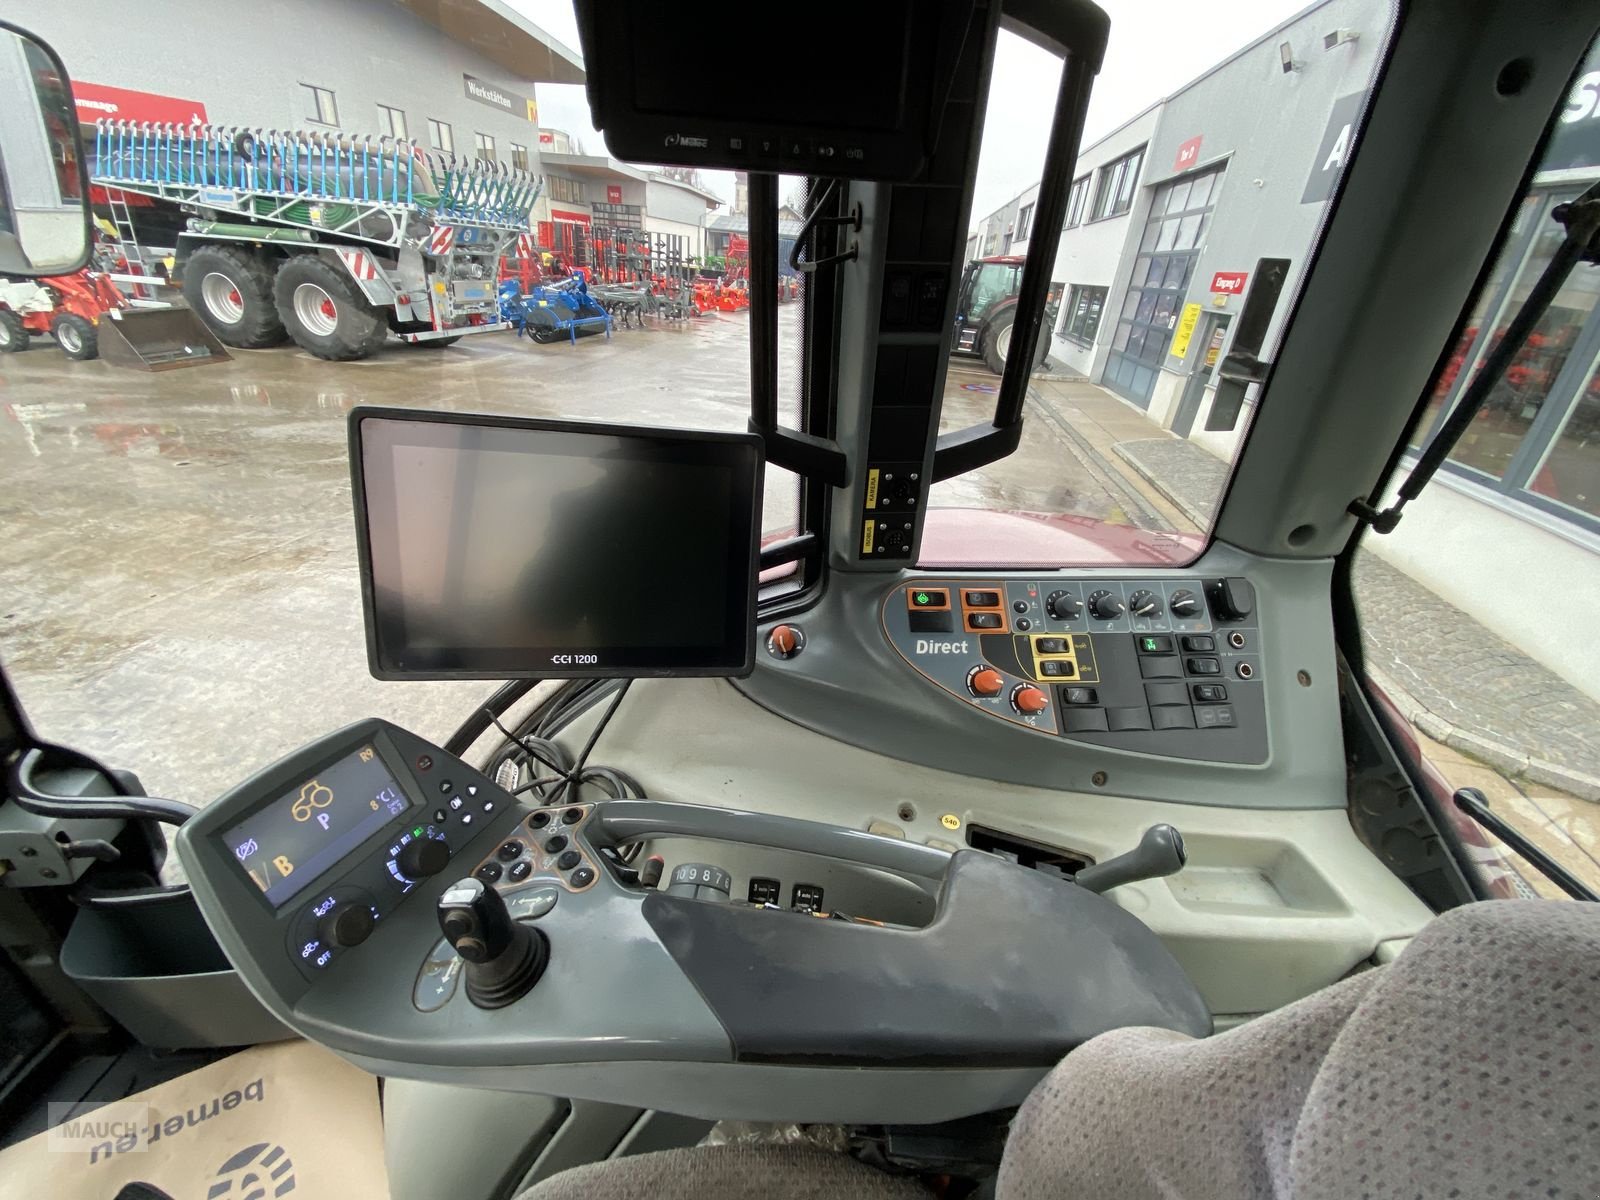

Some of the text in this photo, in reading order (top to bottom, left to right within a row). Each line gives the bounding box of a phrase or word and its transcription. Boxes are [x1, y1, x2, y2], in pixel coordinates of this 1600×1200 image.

[467, 80, 512, 108] Werkstätten
[916, 640, 969, 654] Direct
[574, 654, 598, 664] 1200
[316, 812, 330, 831] P
[944, 818, 958, 826] 540
[272, 854, 295, 878] B
[676, 868, 687, 880] 10
[688, 867, 698, 880] 9
[702, 869, 712, 882] 8
[715, 872, 723, 885] 7
[317, 950, 332, 966] OFF
[89, 1078, 264, 1165] berner.eu
